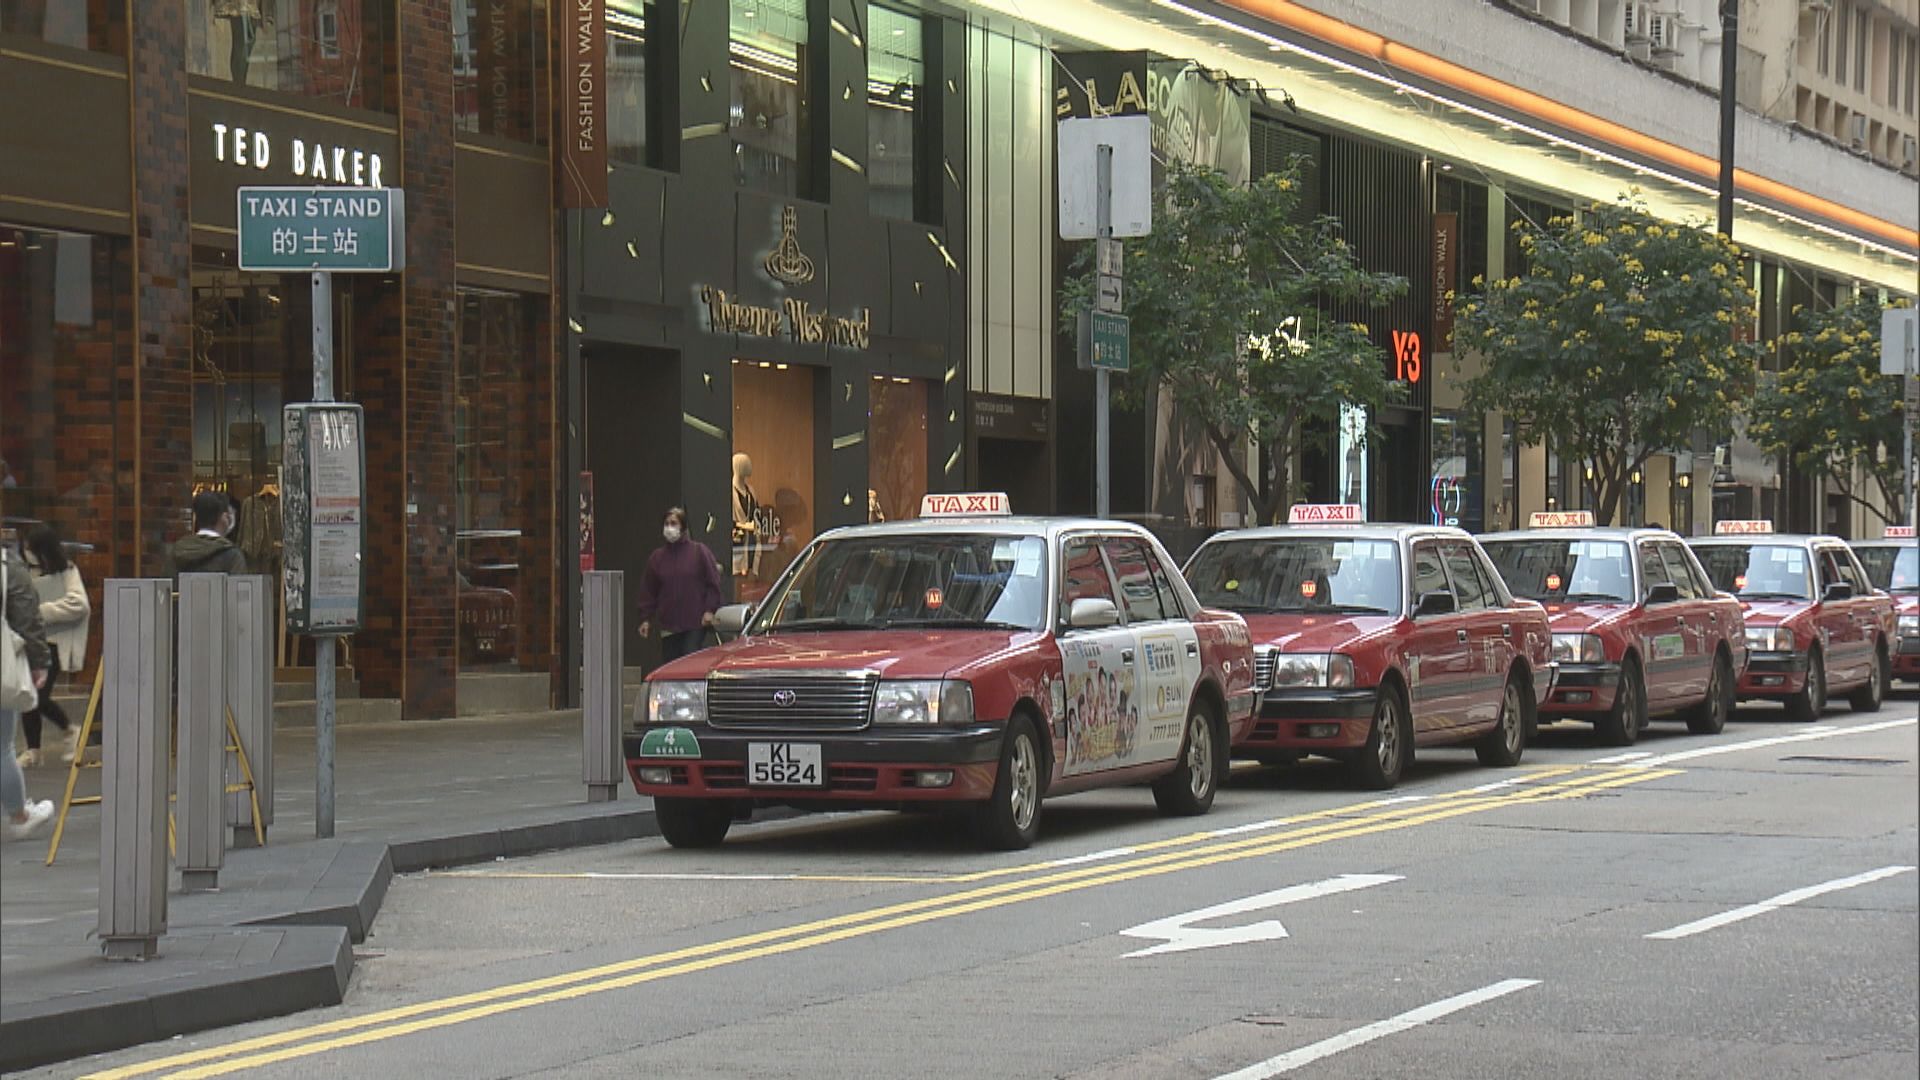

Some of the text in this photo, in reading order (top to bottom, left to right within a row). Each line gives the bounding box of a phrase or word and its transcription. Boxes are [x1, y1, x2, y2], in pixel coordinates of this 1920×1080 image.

[578, 0, 593, 152] FASHION WALK
[213, 123, 382, 190] TED BAKER
[247, 197, 382, 217] TAXI STAND
[271, 227, 358, 256] 的士站
[1435, 228, 1448, 321] FASHION WALK
[1107, 321, 1127, 337] STAND
[927, 495, 1000, 513] TAXI
[1294, 505, 1354, 520] TAXI
[753, 507, 781, 536] Sale
[1535, 512, 1586, 526] TAXI
[1720, 521, 1766, 533] TAXI
[1887, 527, 1912, 536] TAXI
[926, 592, 942, 604] TAXI
[664, 728, 675, 745] 4
[770, 743, 801, 764] KL
[754, 762, 817, 784] 5624
